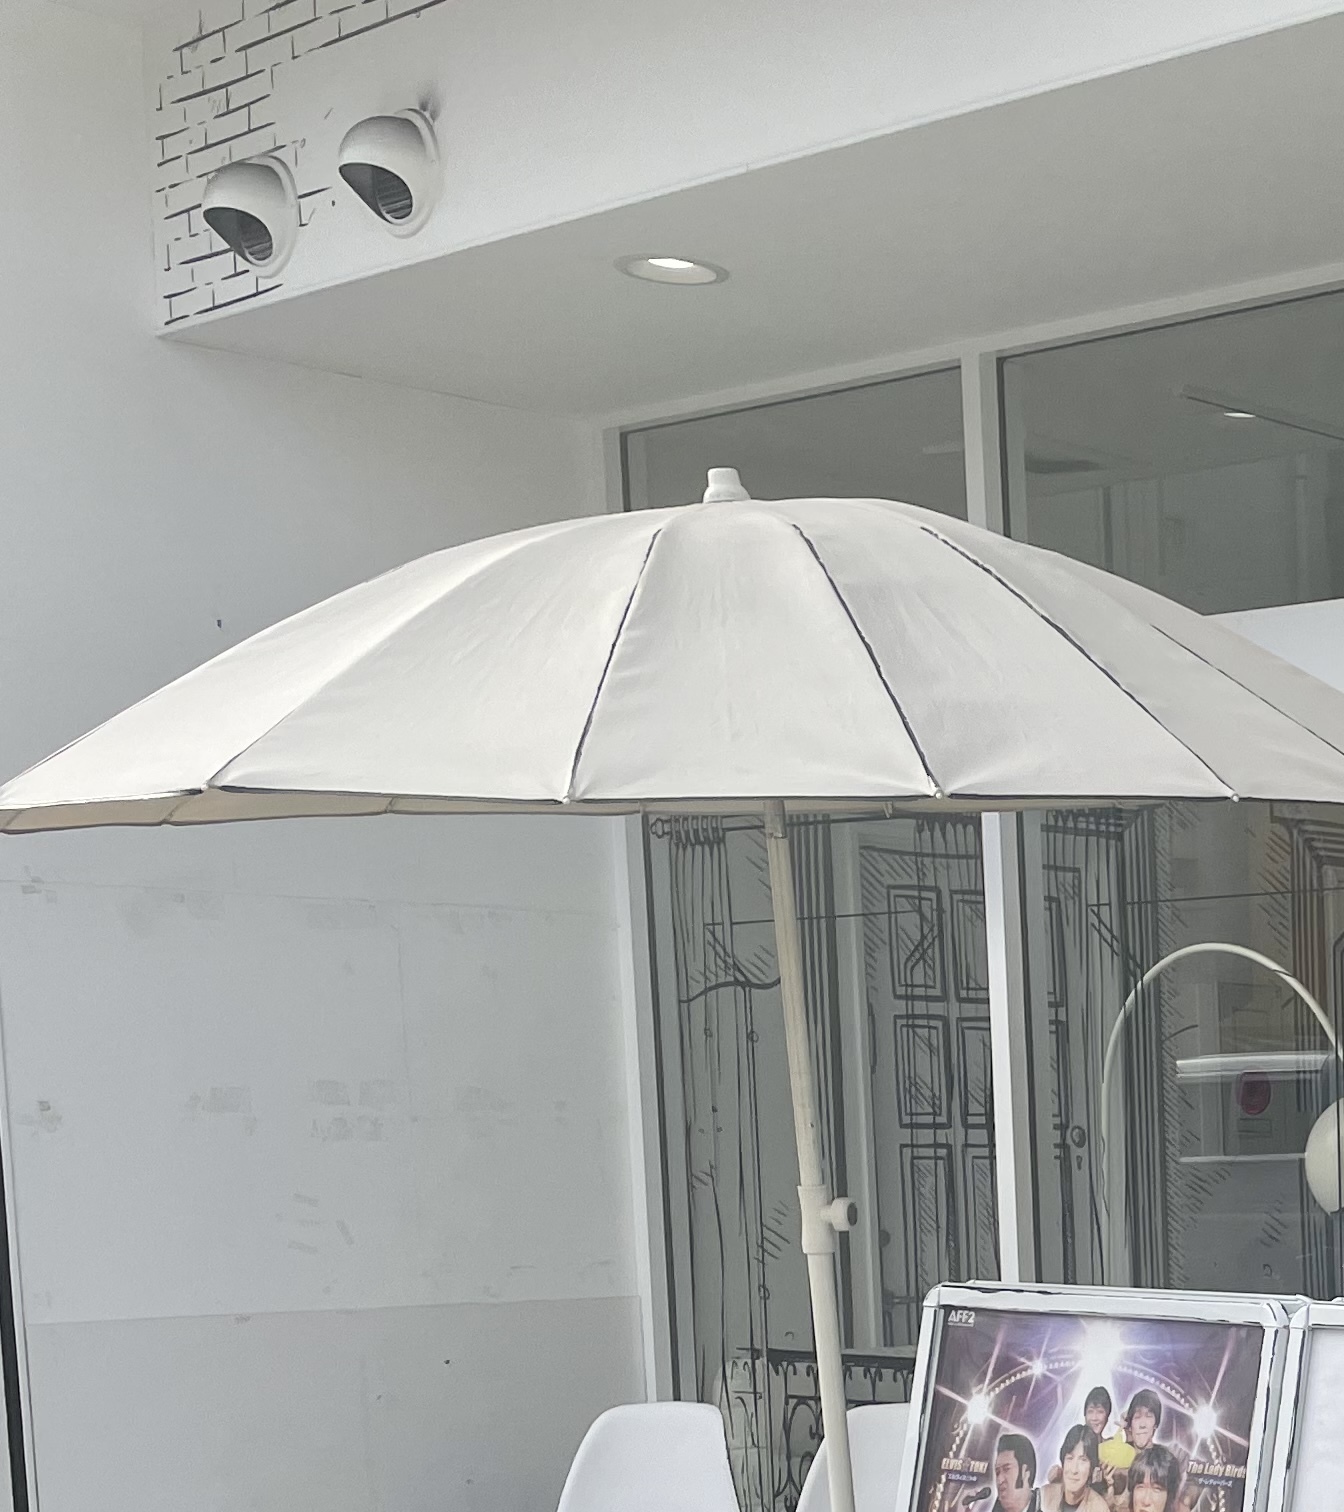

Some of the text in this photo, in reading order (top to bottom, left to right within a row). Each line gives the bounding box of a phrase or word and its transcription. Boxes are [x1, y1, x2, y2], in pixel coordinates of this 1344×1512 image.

[948, 1310, 975, 1323] AFF2
[1187, 1461, 1204, 1473] The
[1204, 1463, 1225, 1476] Lady
